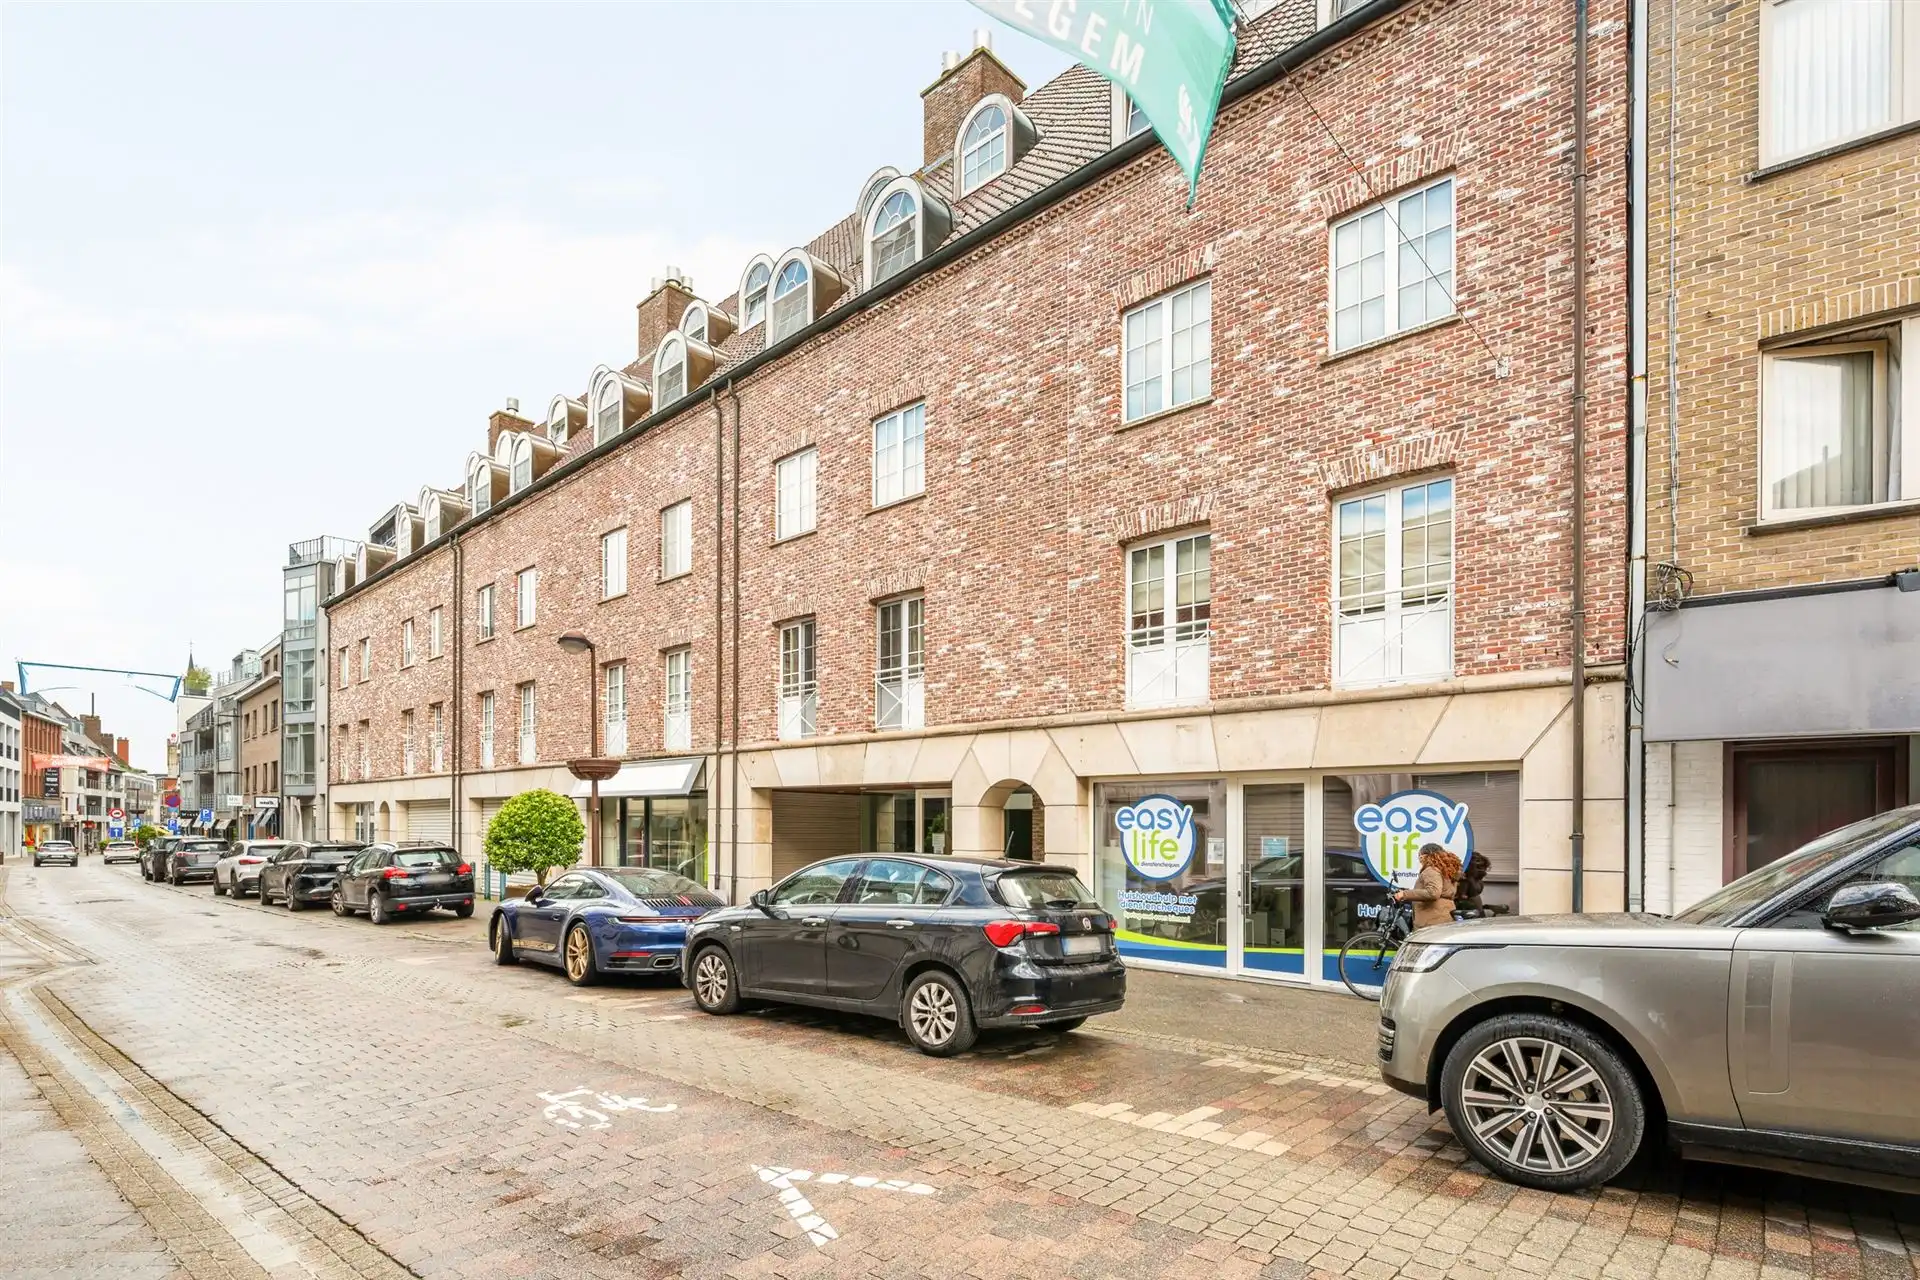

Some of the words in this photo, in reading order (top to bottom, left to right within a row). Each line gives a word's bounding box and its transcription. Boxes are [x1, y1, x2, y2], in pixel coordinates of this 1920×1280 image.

[1117, 807, 1192, 839] easy
[1357, 806, 1465, 844] easy
[1132, 829, 1179, 867] life
[1380, 832, 1421, 877] lif
[1117, 890, 1177, 904] Huishoudhulp
[1178, 895, 1198, 906] met
[1120, 900, 1196, 915] dienstencheques
